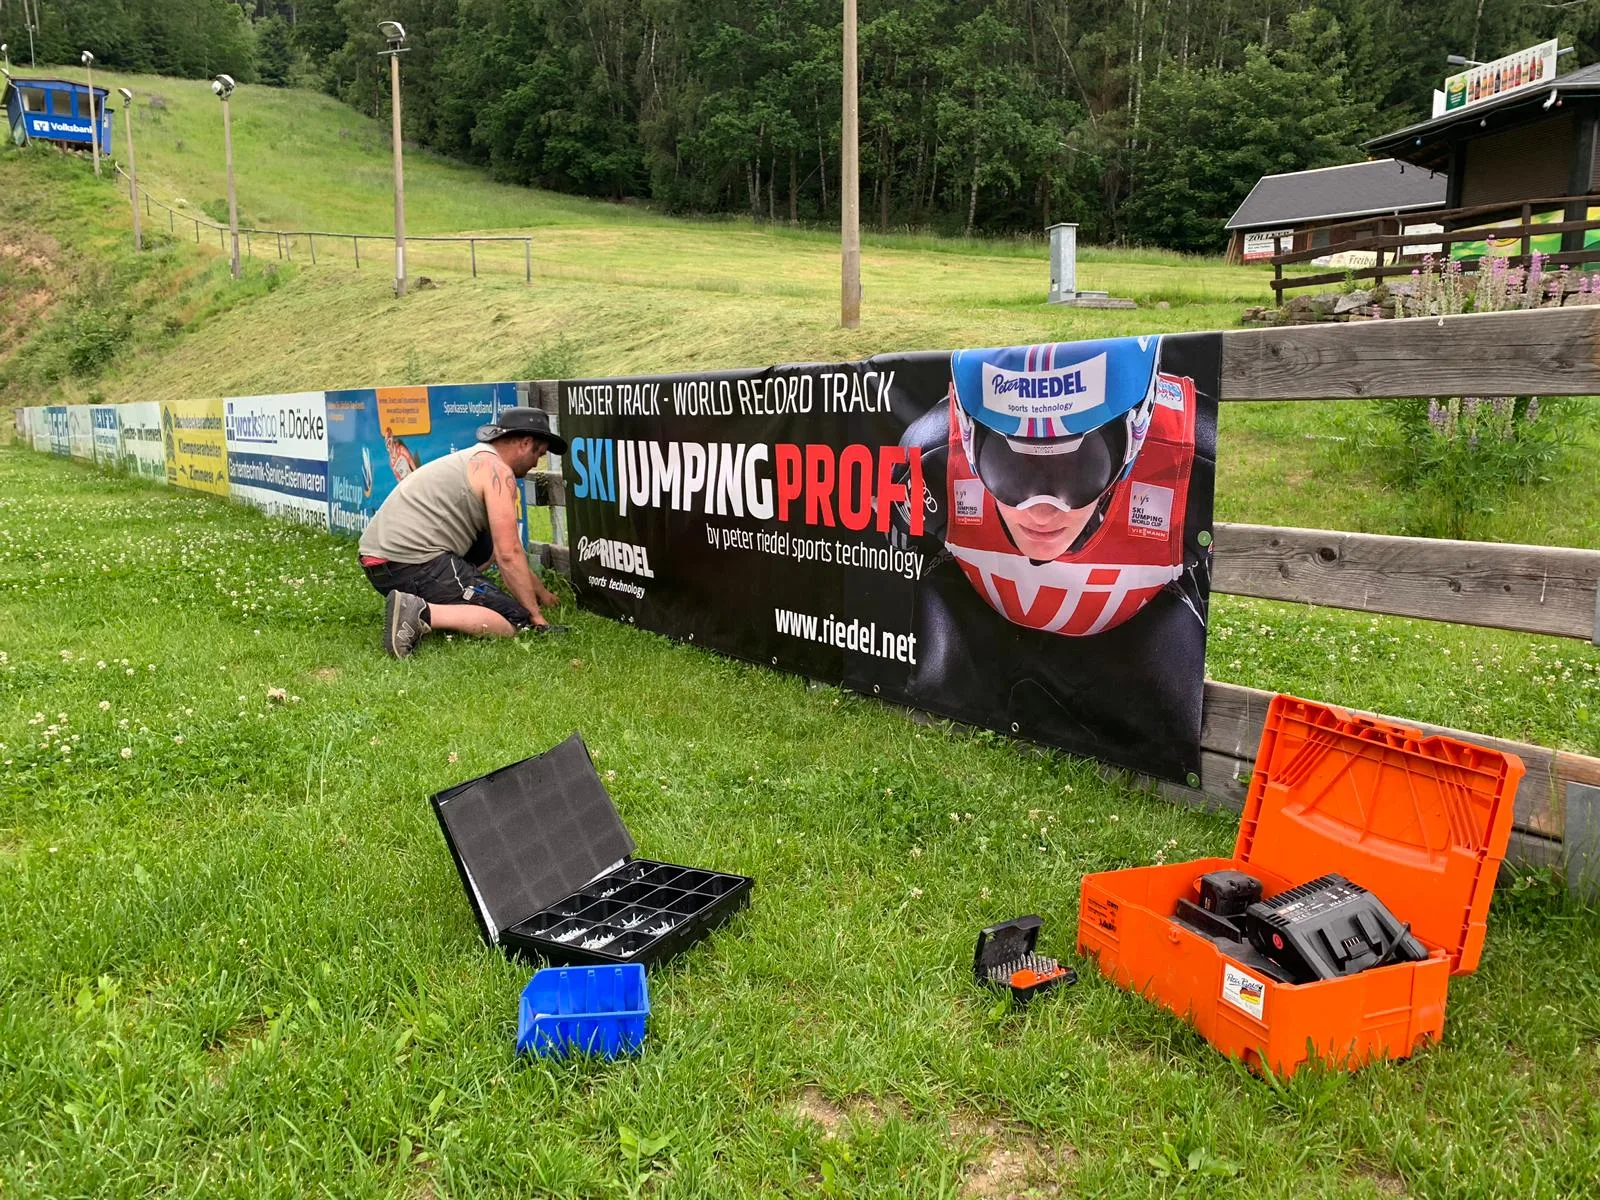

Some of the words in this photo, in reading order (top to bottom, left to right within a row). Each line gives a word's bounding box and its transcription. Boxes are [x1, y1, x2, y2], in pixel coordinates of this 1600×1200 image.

[568, 384, 612, 416] MASTER
[617, 383, 660, 416] TRACK
[673, 380, 732, 416] WORLD
[738, 374, 813, 415] RECORD
[820, 371, 895, 413] TRACK
[992, 373, 1020, 395] Peter
[1018, 370, 1087, 398] RIEDEL
[443, 401, 468, 415] Sparkasse
[468, 400, 493, 416] Vogtland
[1008, 403, 1028, 413] sports
[1031, 402, 1074, 413] technology
[332, 475, 363, 510] Weltcup
[331, 501, 370, 536] Klingenth
[1132, 513, 1163, 523] JUMPING
[577, 535, 602, 562] Peter
[599, 538, 655, 579] RIEDEL
[706, 522, 720, 550] by
[723, 527, 754, 552] peter
[757, 531, 790, 556] riedel
[792, 537, 832, 563] sports
[836, 540, 924, 581] technology
[588, 575, 607, 588] sports
[608, 578, 646, 600] technology
[775, 608, 917, 665] www.riedel.net
